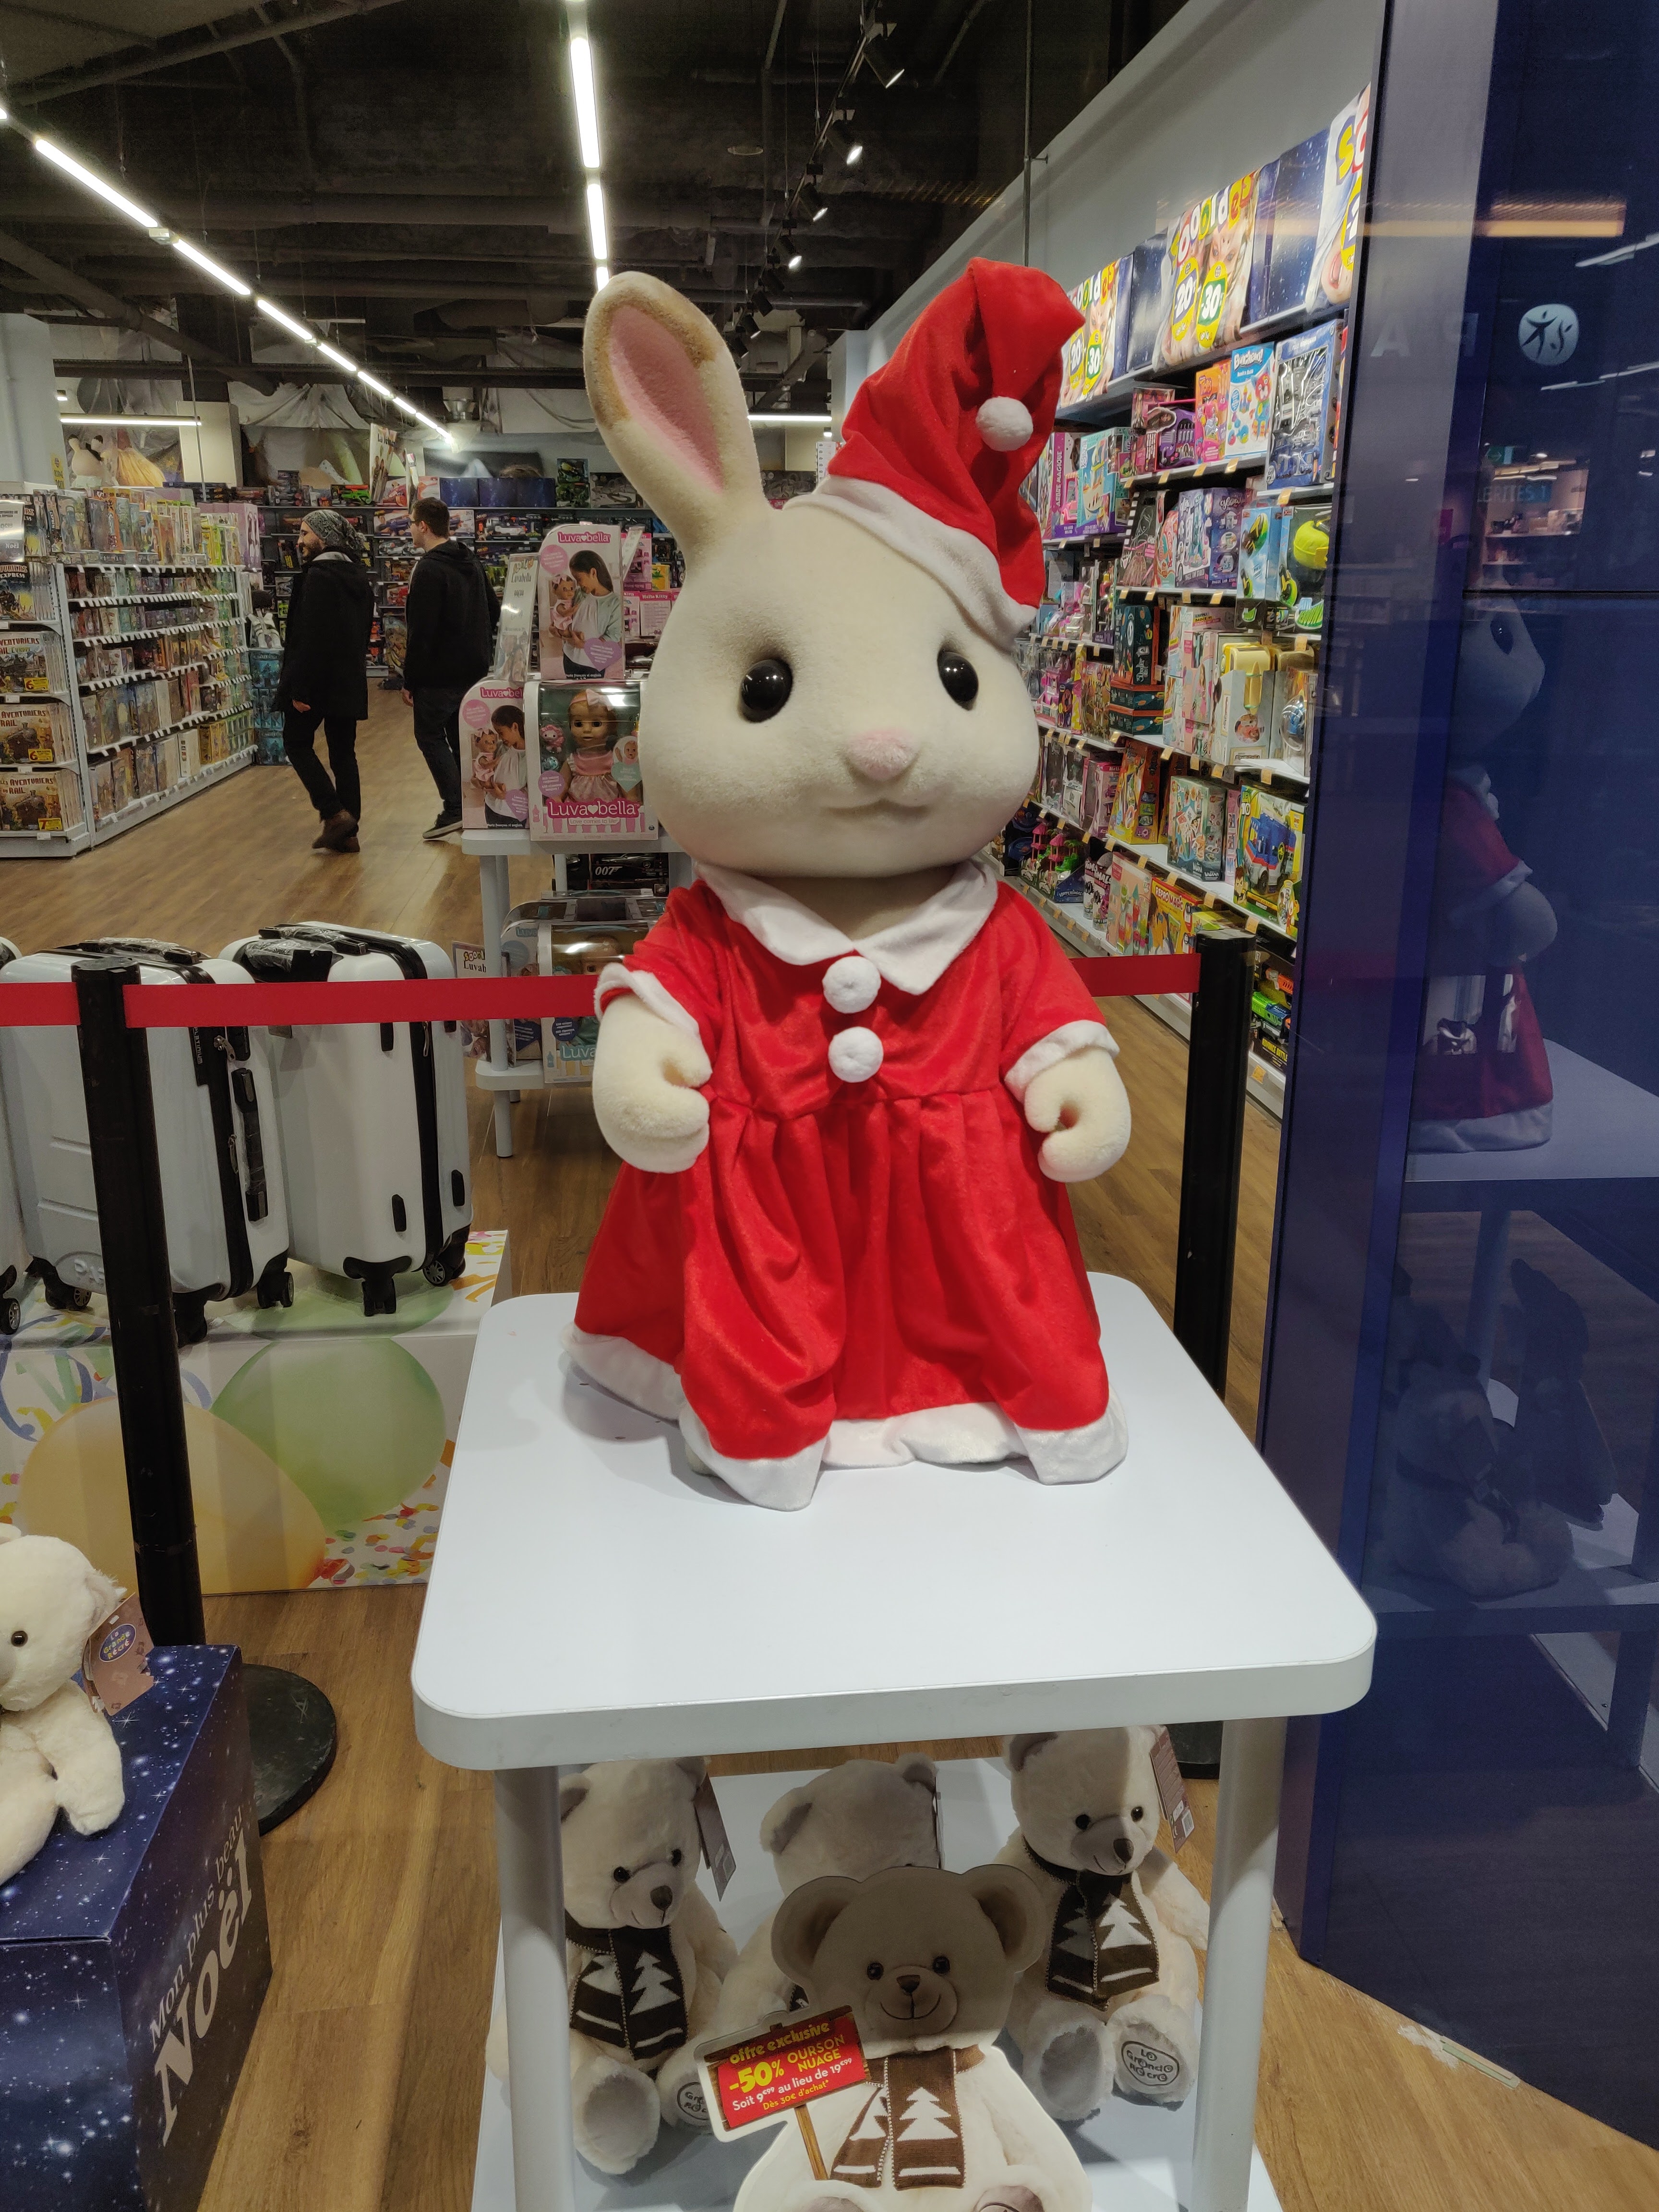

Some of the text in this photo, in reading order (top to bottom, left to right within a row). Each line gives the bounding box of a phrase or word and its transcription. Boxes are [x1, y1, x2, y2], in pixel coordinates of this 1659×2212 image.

[559, 533, 609, 542] Luvabella
[482, 688, 523, 697] Luvabel
[549, 801, 636, 816] Luvabella
[595, 866, 623, 876] 007
[1155, 886, 1169, 902] REPRO
[464, 950, 485, 962] Soool
[464, 960, 486, 973] Luvab
[104, 1631, 131, 1654] Grande
[111, 1631, 120, 1640] La
[150, 1805, 242, 2054] Mon plus beau
[155, 1827, 252, 2148] Noël
[729, 2022, 830, 2064] offre exclusive
[729, 2034, 845, 2093] -50% OURSON
[797, 2048, 842, 2072] NUAGE
[732, 2097, 755, 2111] Soit
[778, 2083, 792, 2094] au
[792, 2075, 813, 2088] lieu
[814, 2068, 829, 2080] de
[763, 2099, 779, 2111] Dès
[780, 2092, 797, 2105] 30€
